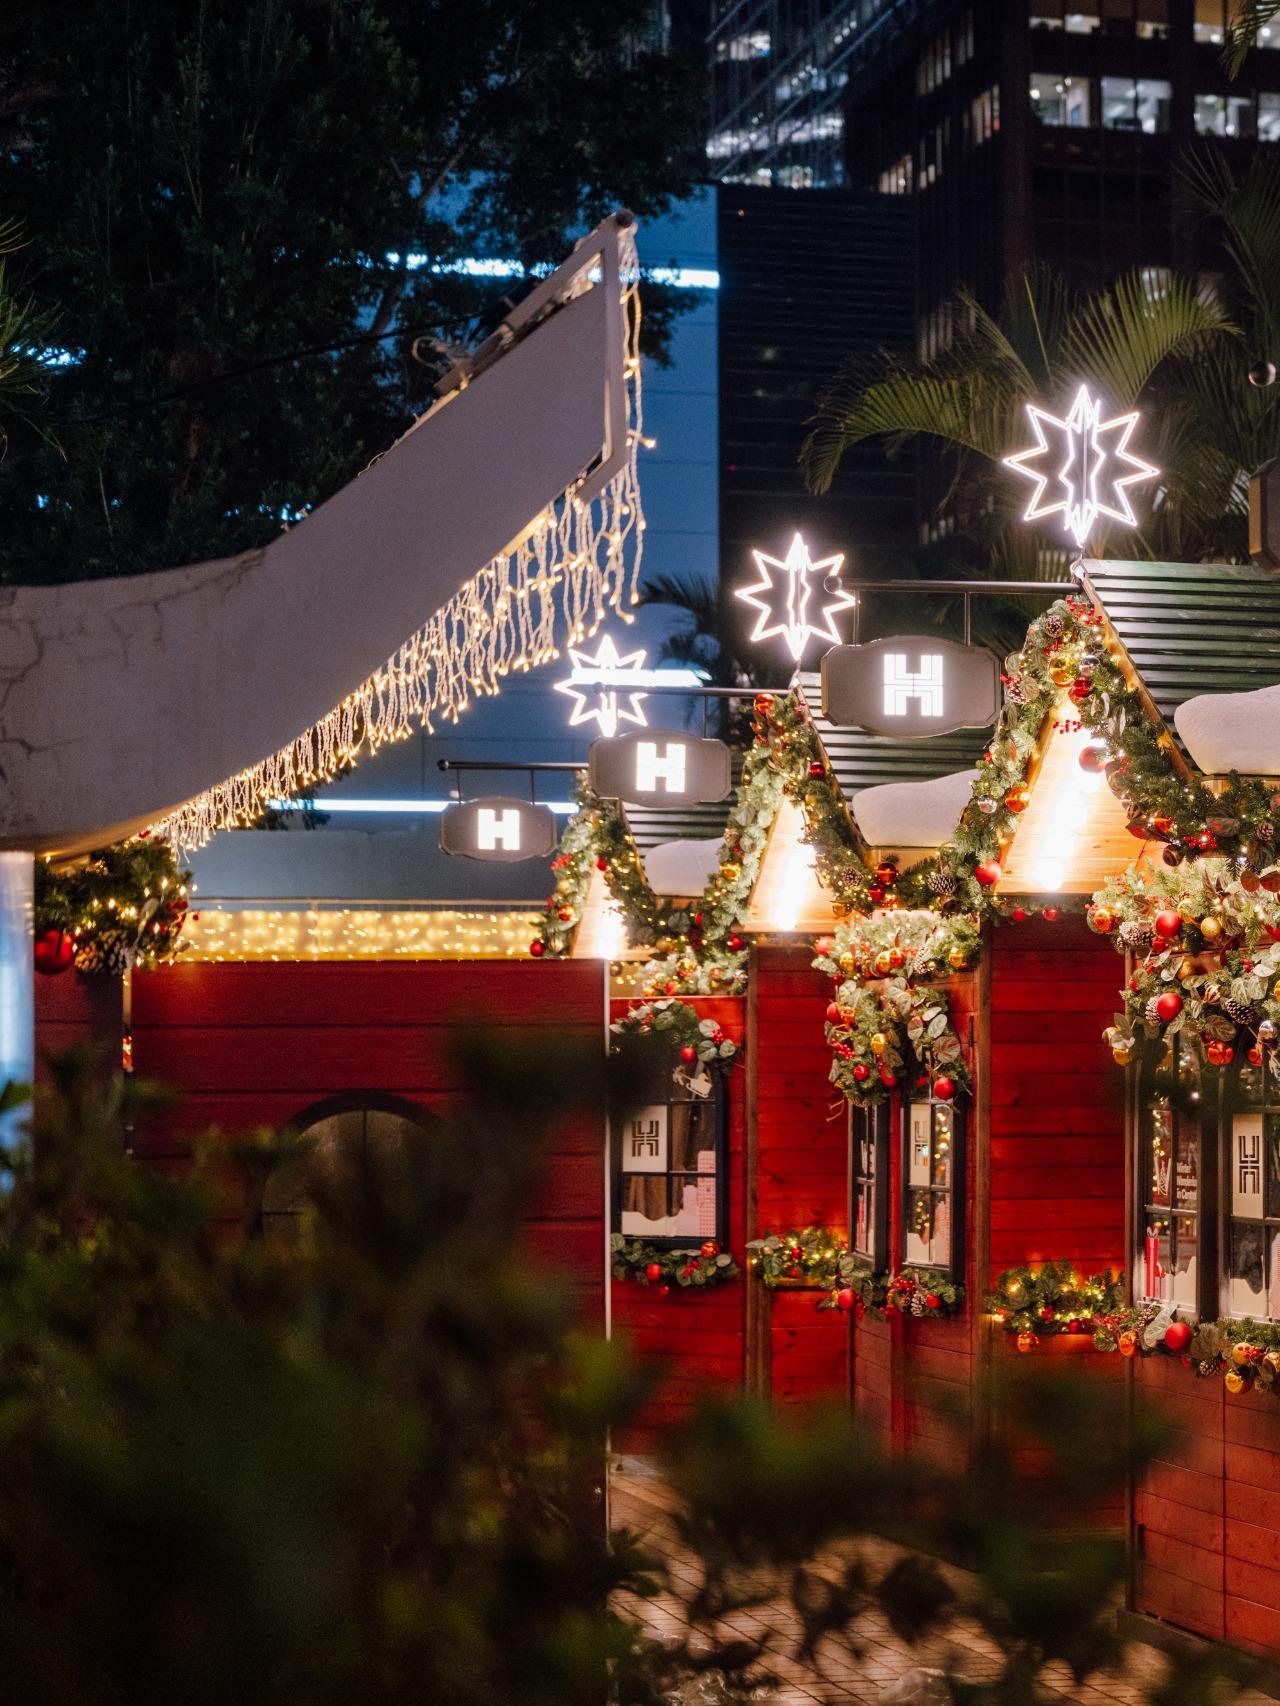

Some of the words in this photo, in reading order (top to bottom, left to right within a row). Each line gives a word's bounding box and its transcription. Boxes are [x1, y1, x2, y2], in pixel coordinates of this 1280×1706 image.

[883, 653, 944, 717] H
[636, 742, 686, 793] H
[477, 808, 520, 851] H
